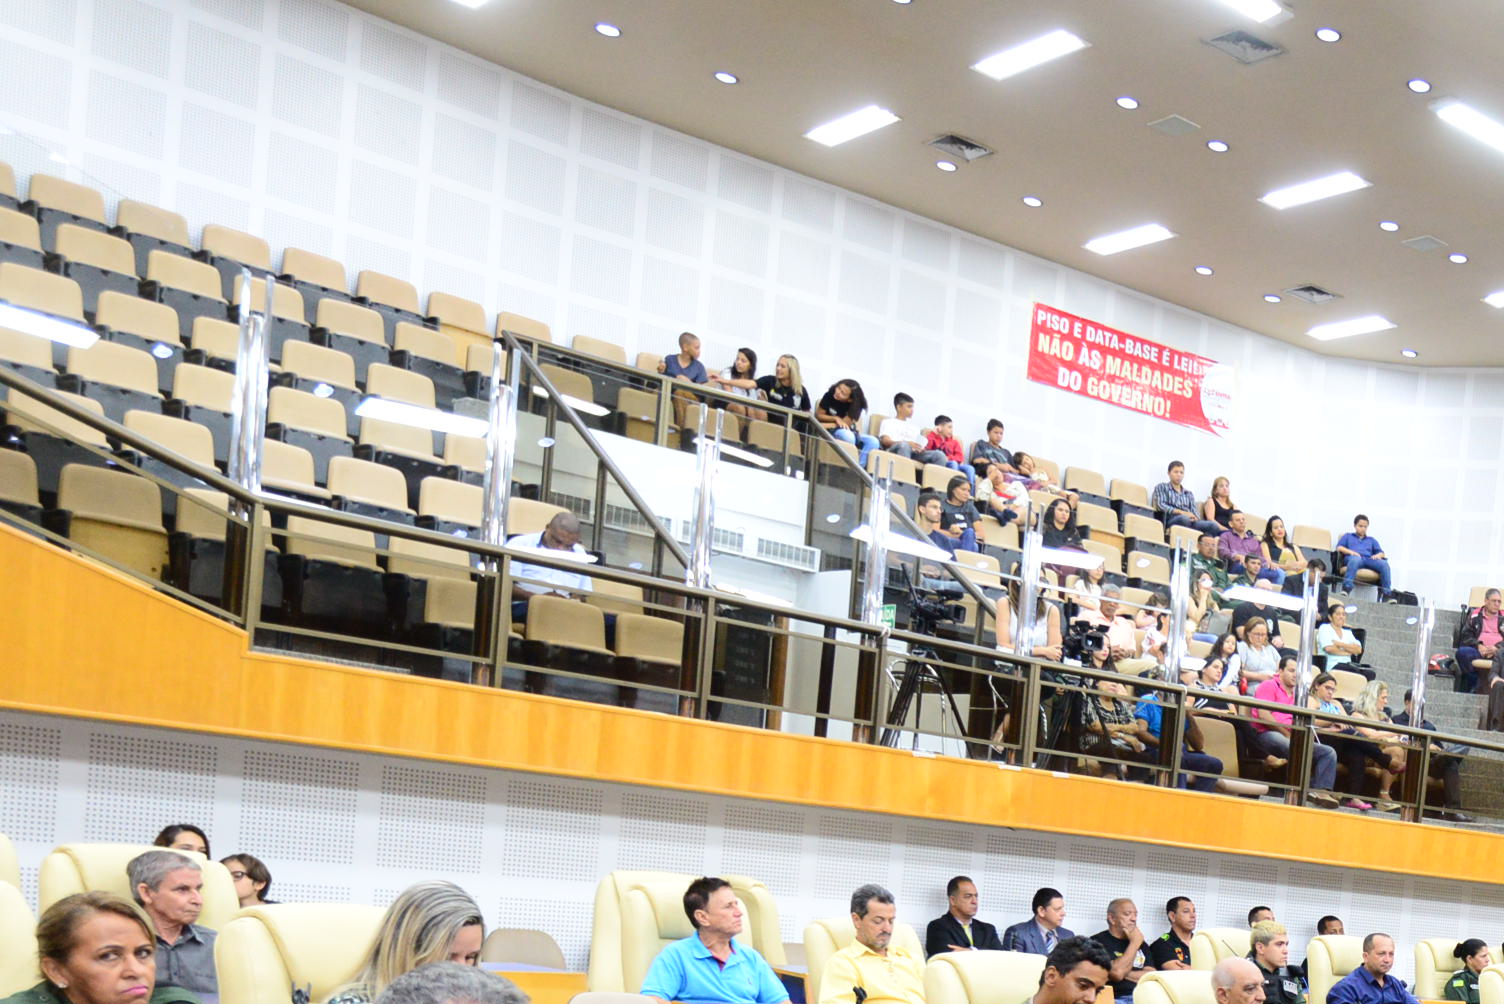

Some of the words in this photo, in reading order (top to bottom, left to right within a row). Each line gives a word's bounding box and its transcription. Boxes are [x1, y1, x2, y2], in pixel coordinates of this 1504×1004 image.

[1037, 309, 1069, 334] PISO
[1073, 321, 1083, 338] E
[1086, 325, 1159, 363] DATA-BASE
[1162, 347, 1171, 366] É
[1037, 332, 1074, 361] NÃO
[1078, 341, 1101, 370] ÀS
[1105, 354, 1193, 398] MALDADES
[1057, 366, 1082, 391] DO
[1086, 376, 1172, 418] GOVERNO!
